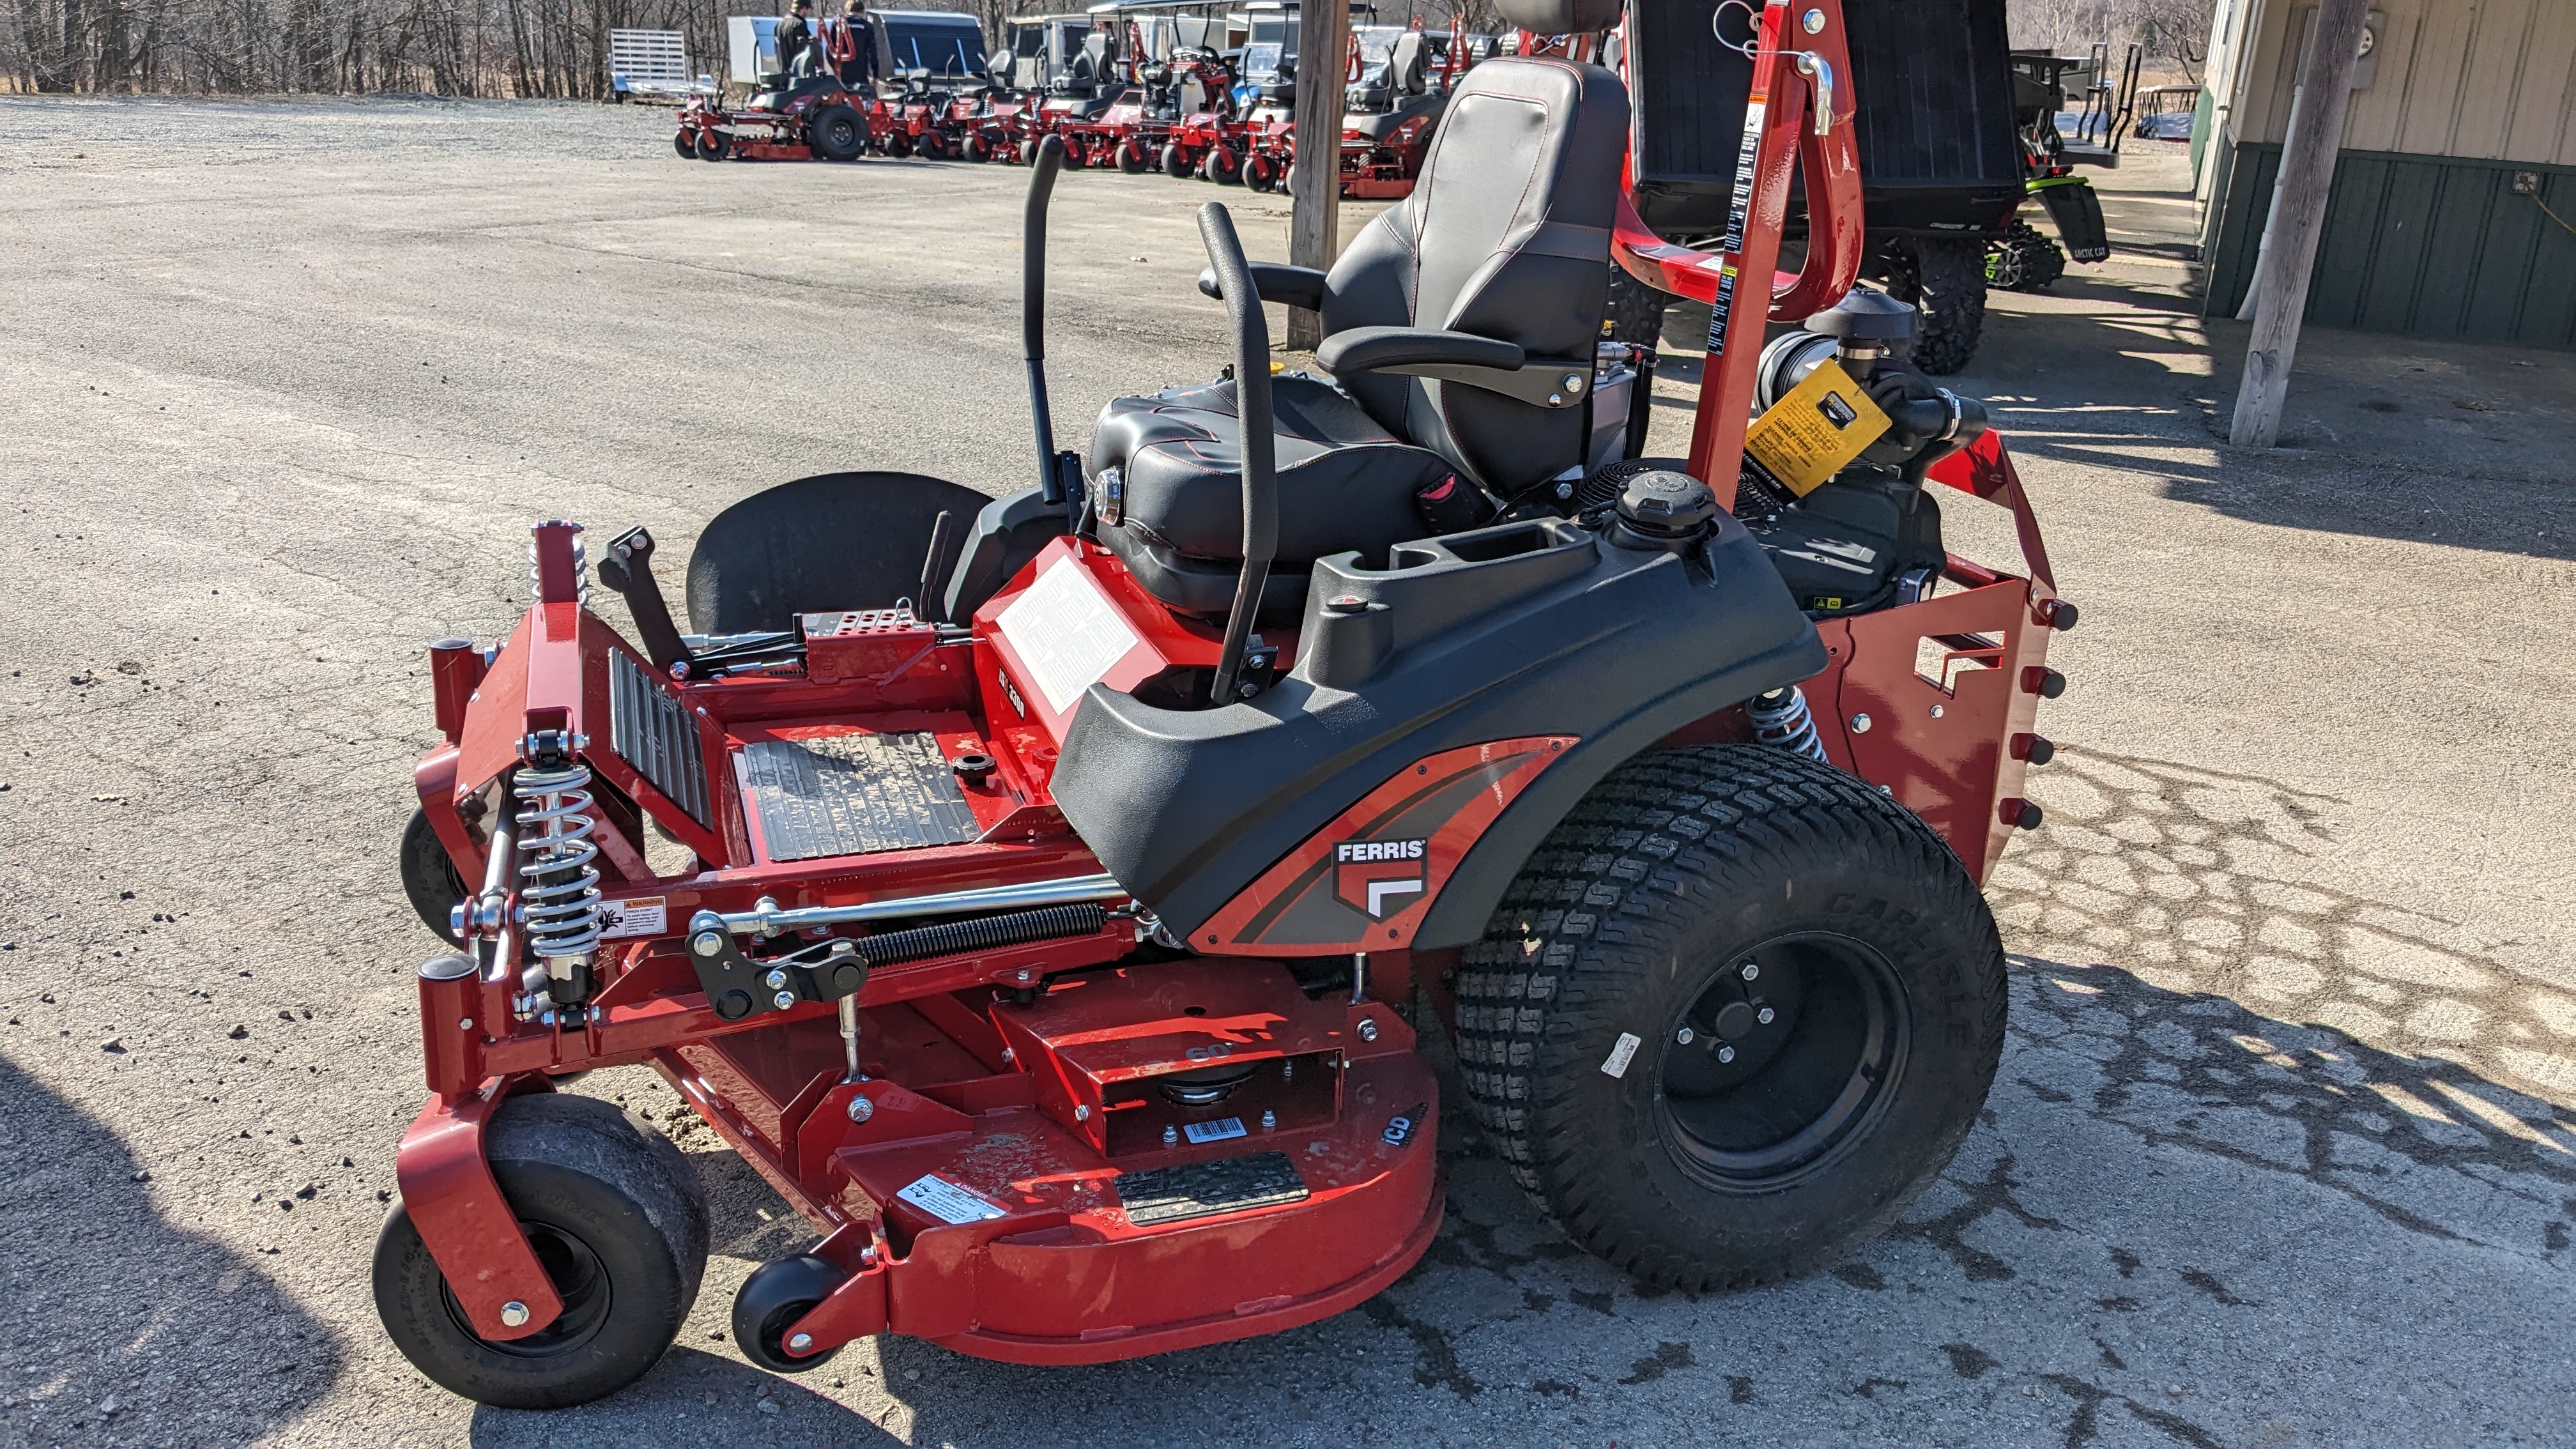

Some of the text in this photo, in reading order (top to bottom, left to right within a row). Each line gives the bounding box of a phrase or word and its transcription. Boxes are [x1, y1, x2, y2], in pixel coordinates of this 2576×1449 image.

[2095, 247, 2106, 257] CAT
[1009, 684, 1024, 718] 3300
[1338, 840, 1423, 862] FERRIS
[1828, 893, 1970, 1046] CARLISLE
[1381, 1117, 1410, 1146] iCD
[960, 1184, 988, 1200] DANGER
